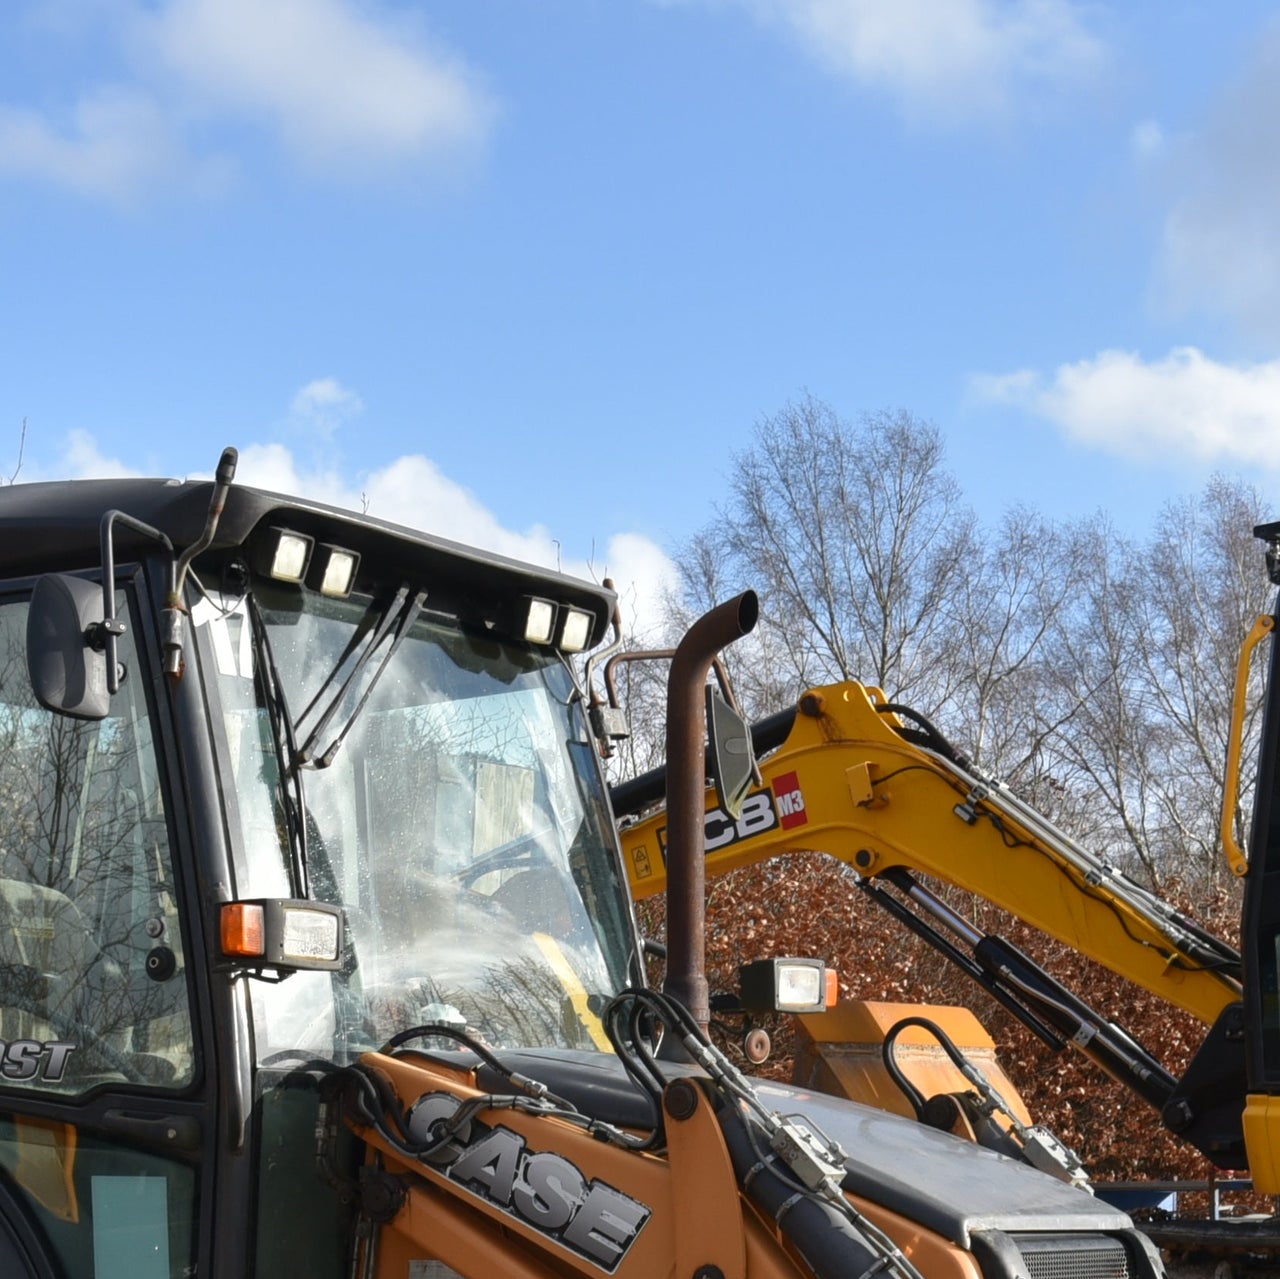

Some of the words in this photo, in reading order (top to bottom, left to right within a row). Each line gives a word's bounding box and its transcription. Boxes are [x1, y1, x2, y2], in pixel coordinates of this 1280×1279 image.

[664, 793, 776, 852] CB
[775, 789, 805, 818] M3
[406, 1093, 650, 1270] CASE
